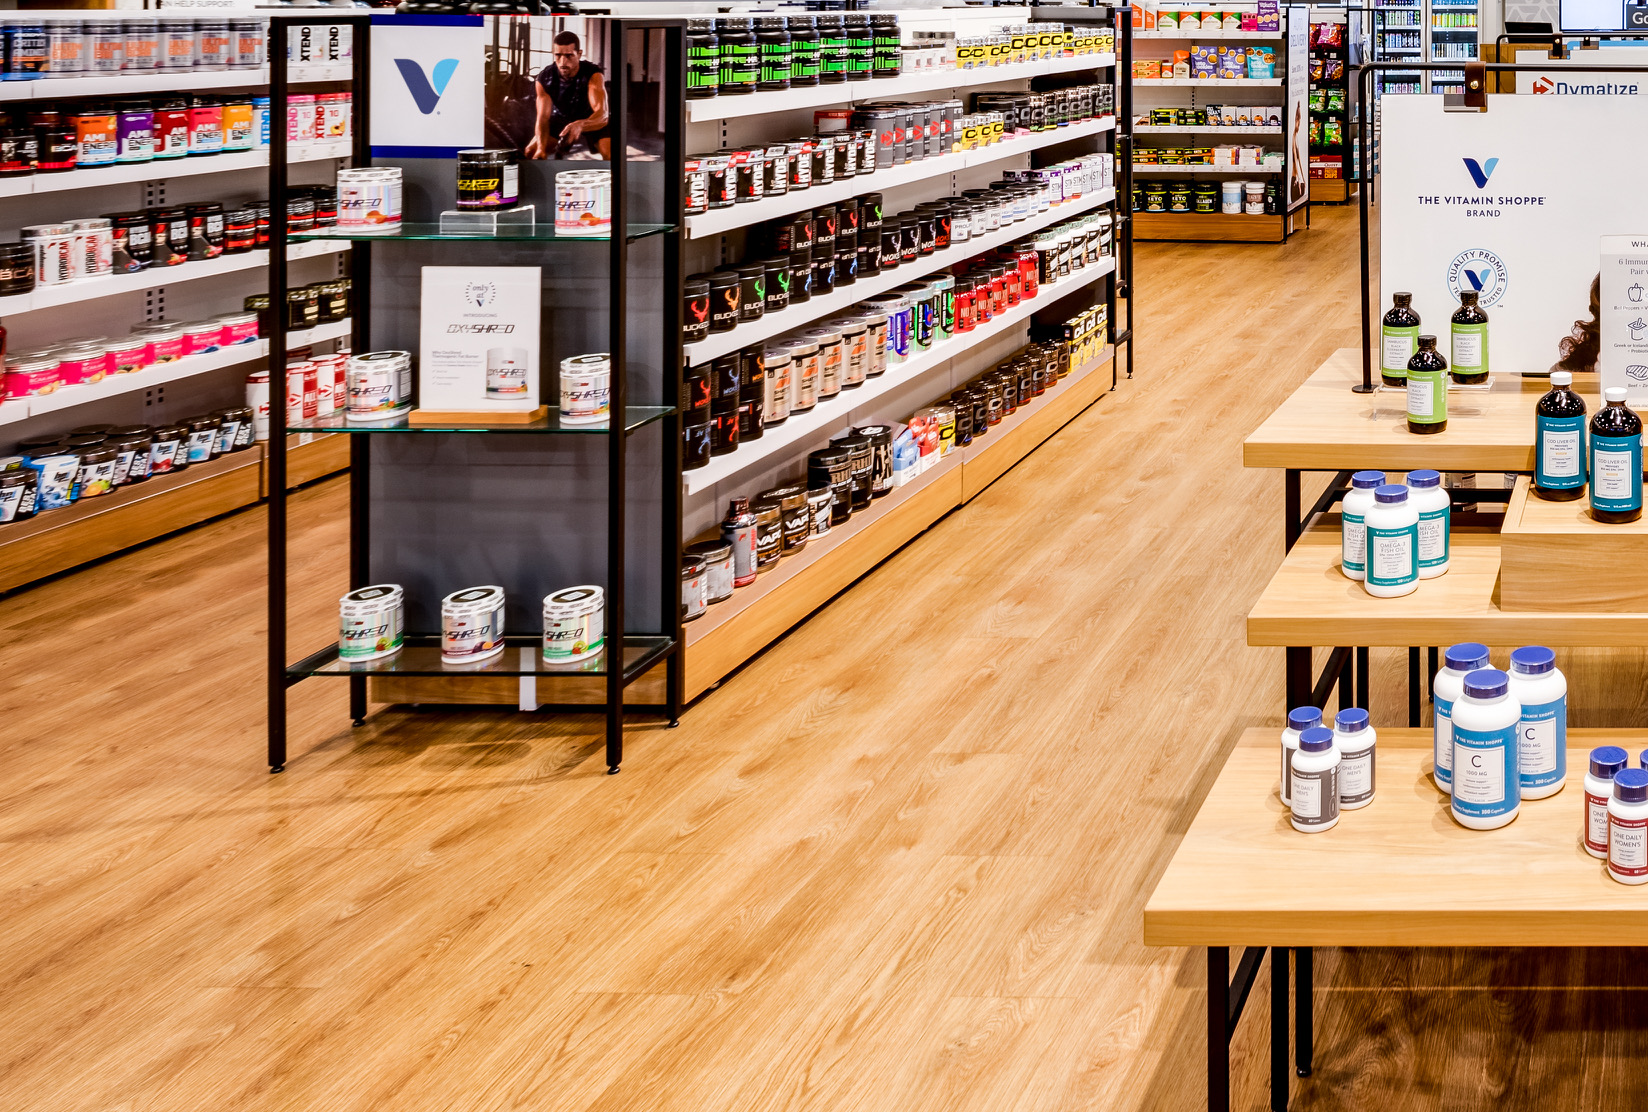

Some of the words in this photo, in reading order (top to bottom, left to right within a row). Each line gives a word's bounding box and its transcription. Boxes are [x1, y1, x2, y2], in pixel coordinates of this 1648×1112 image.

[301, 27, 311, 61] XTEND
[329, 27, 338, 61] XTEND
[1556, 82, 1638, 94] Dymatize
[288, 107, 298, 141] XTEND
[315, 106, 325, 139] XTEND
[799, 153, 810, 182] HYDE
[825, 148, 834, 178] HYDE
[848, 143, 856, 172] HYDE
[865, 140, 876, 168] HYDE
[727, 168, 736, 199] HYDE
[753, 162, 763, 195] HYDE
[775, 158, 787, 188] HYDE
[692, 174, 704, 206] HYDE
[1418, 196, 1440, 205] THE
[1444, 196, 1494, 205] VITAMIN
[1499, 196, 1544, 205] SHOPPE
[1466, 209, 1501, 218] BRAND
[1450, 250, 1475, 283] QUALITY
[1479, 251, 1506, 283] PROMISE
[473, 285, 488, 293] only
[1480, 286, 1503, 305] TRUSTED
[447, 325, 515, 333] OXYSHRED
[1525, 728, 1535, 740] C
[1471, 755, 1481, 767] C
[1614, 831, 1624, 839] ONE
